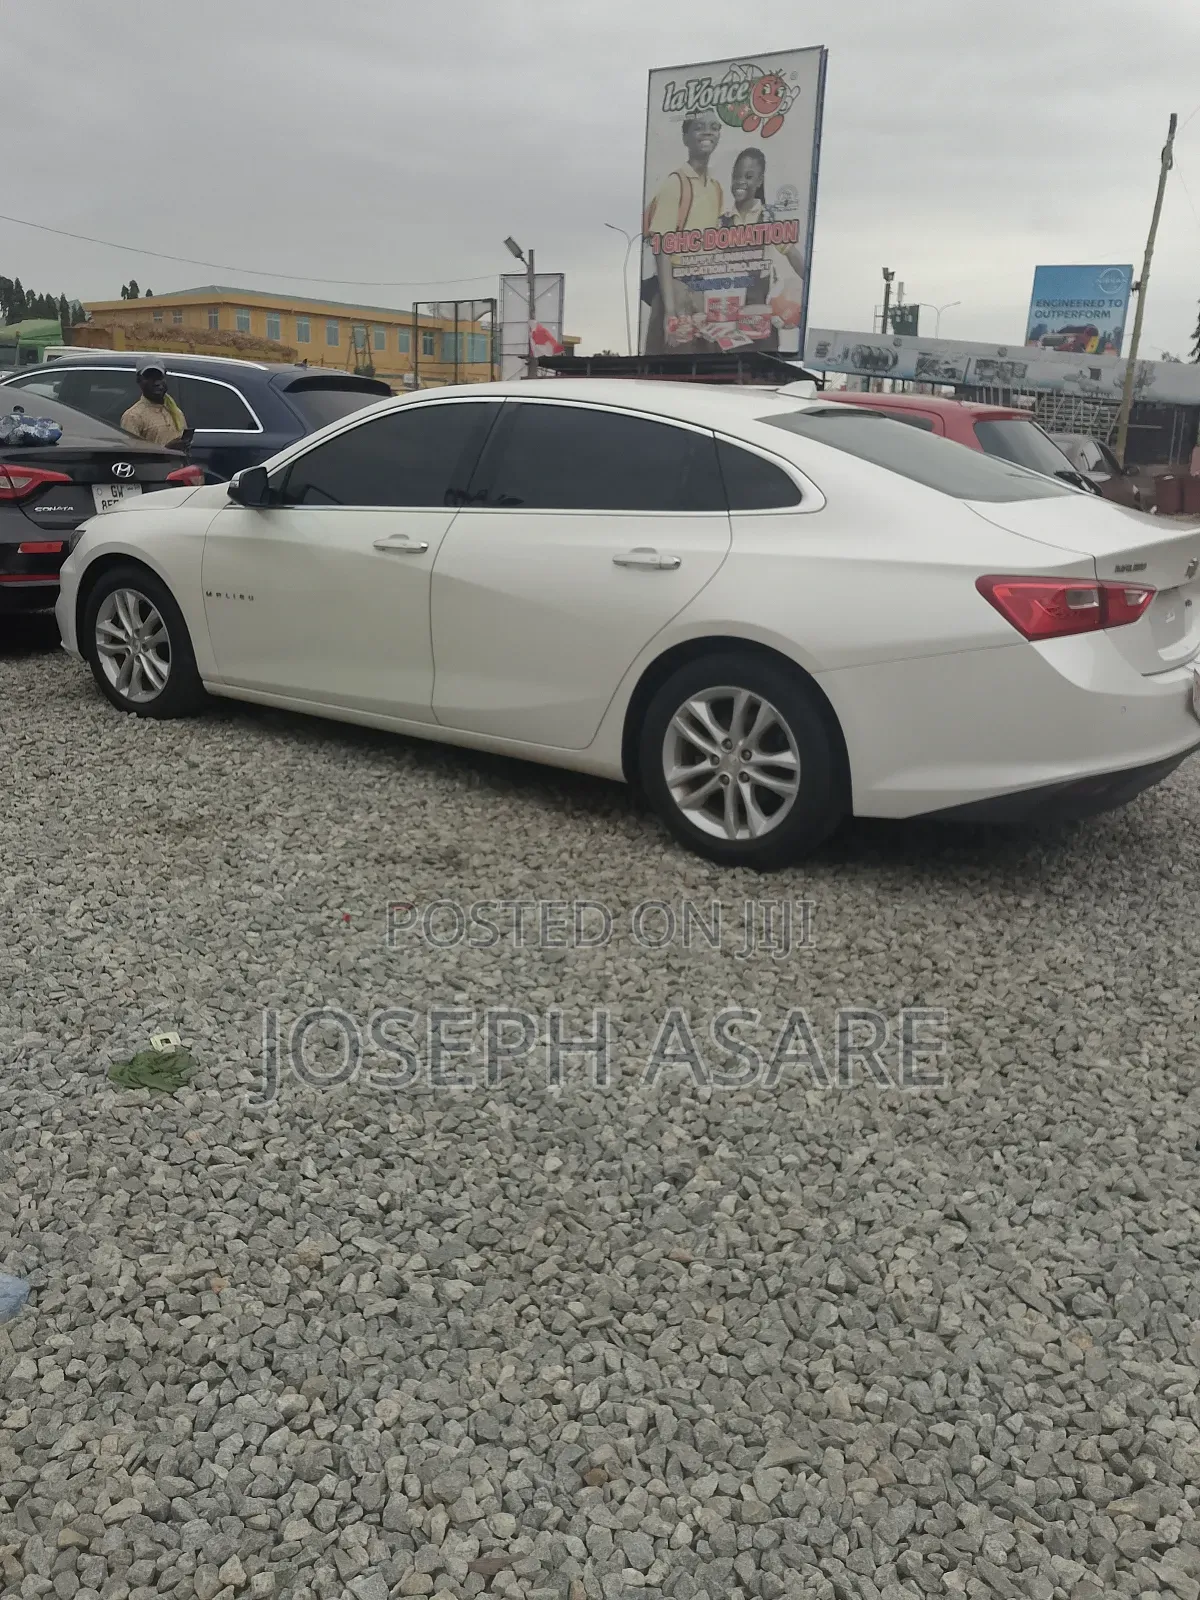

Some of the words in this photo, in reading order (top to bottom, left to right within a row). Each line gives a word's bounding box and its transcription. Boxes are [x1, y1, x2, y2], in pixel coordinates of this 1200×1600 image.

[652, 232, 661, 255] 1
[662, 229, 701, 254] GHC
[703, 219, 799, 250] DONATION
[1035, 298, 1105, 308] ENGINEERED
[1108, 298, 1123, 308] TO
[1034, 310, 1111, 319] OUTPERFORM
[110, 484, 124, 498] GW
